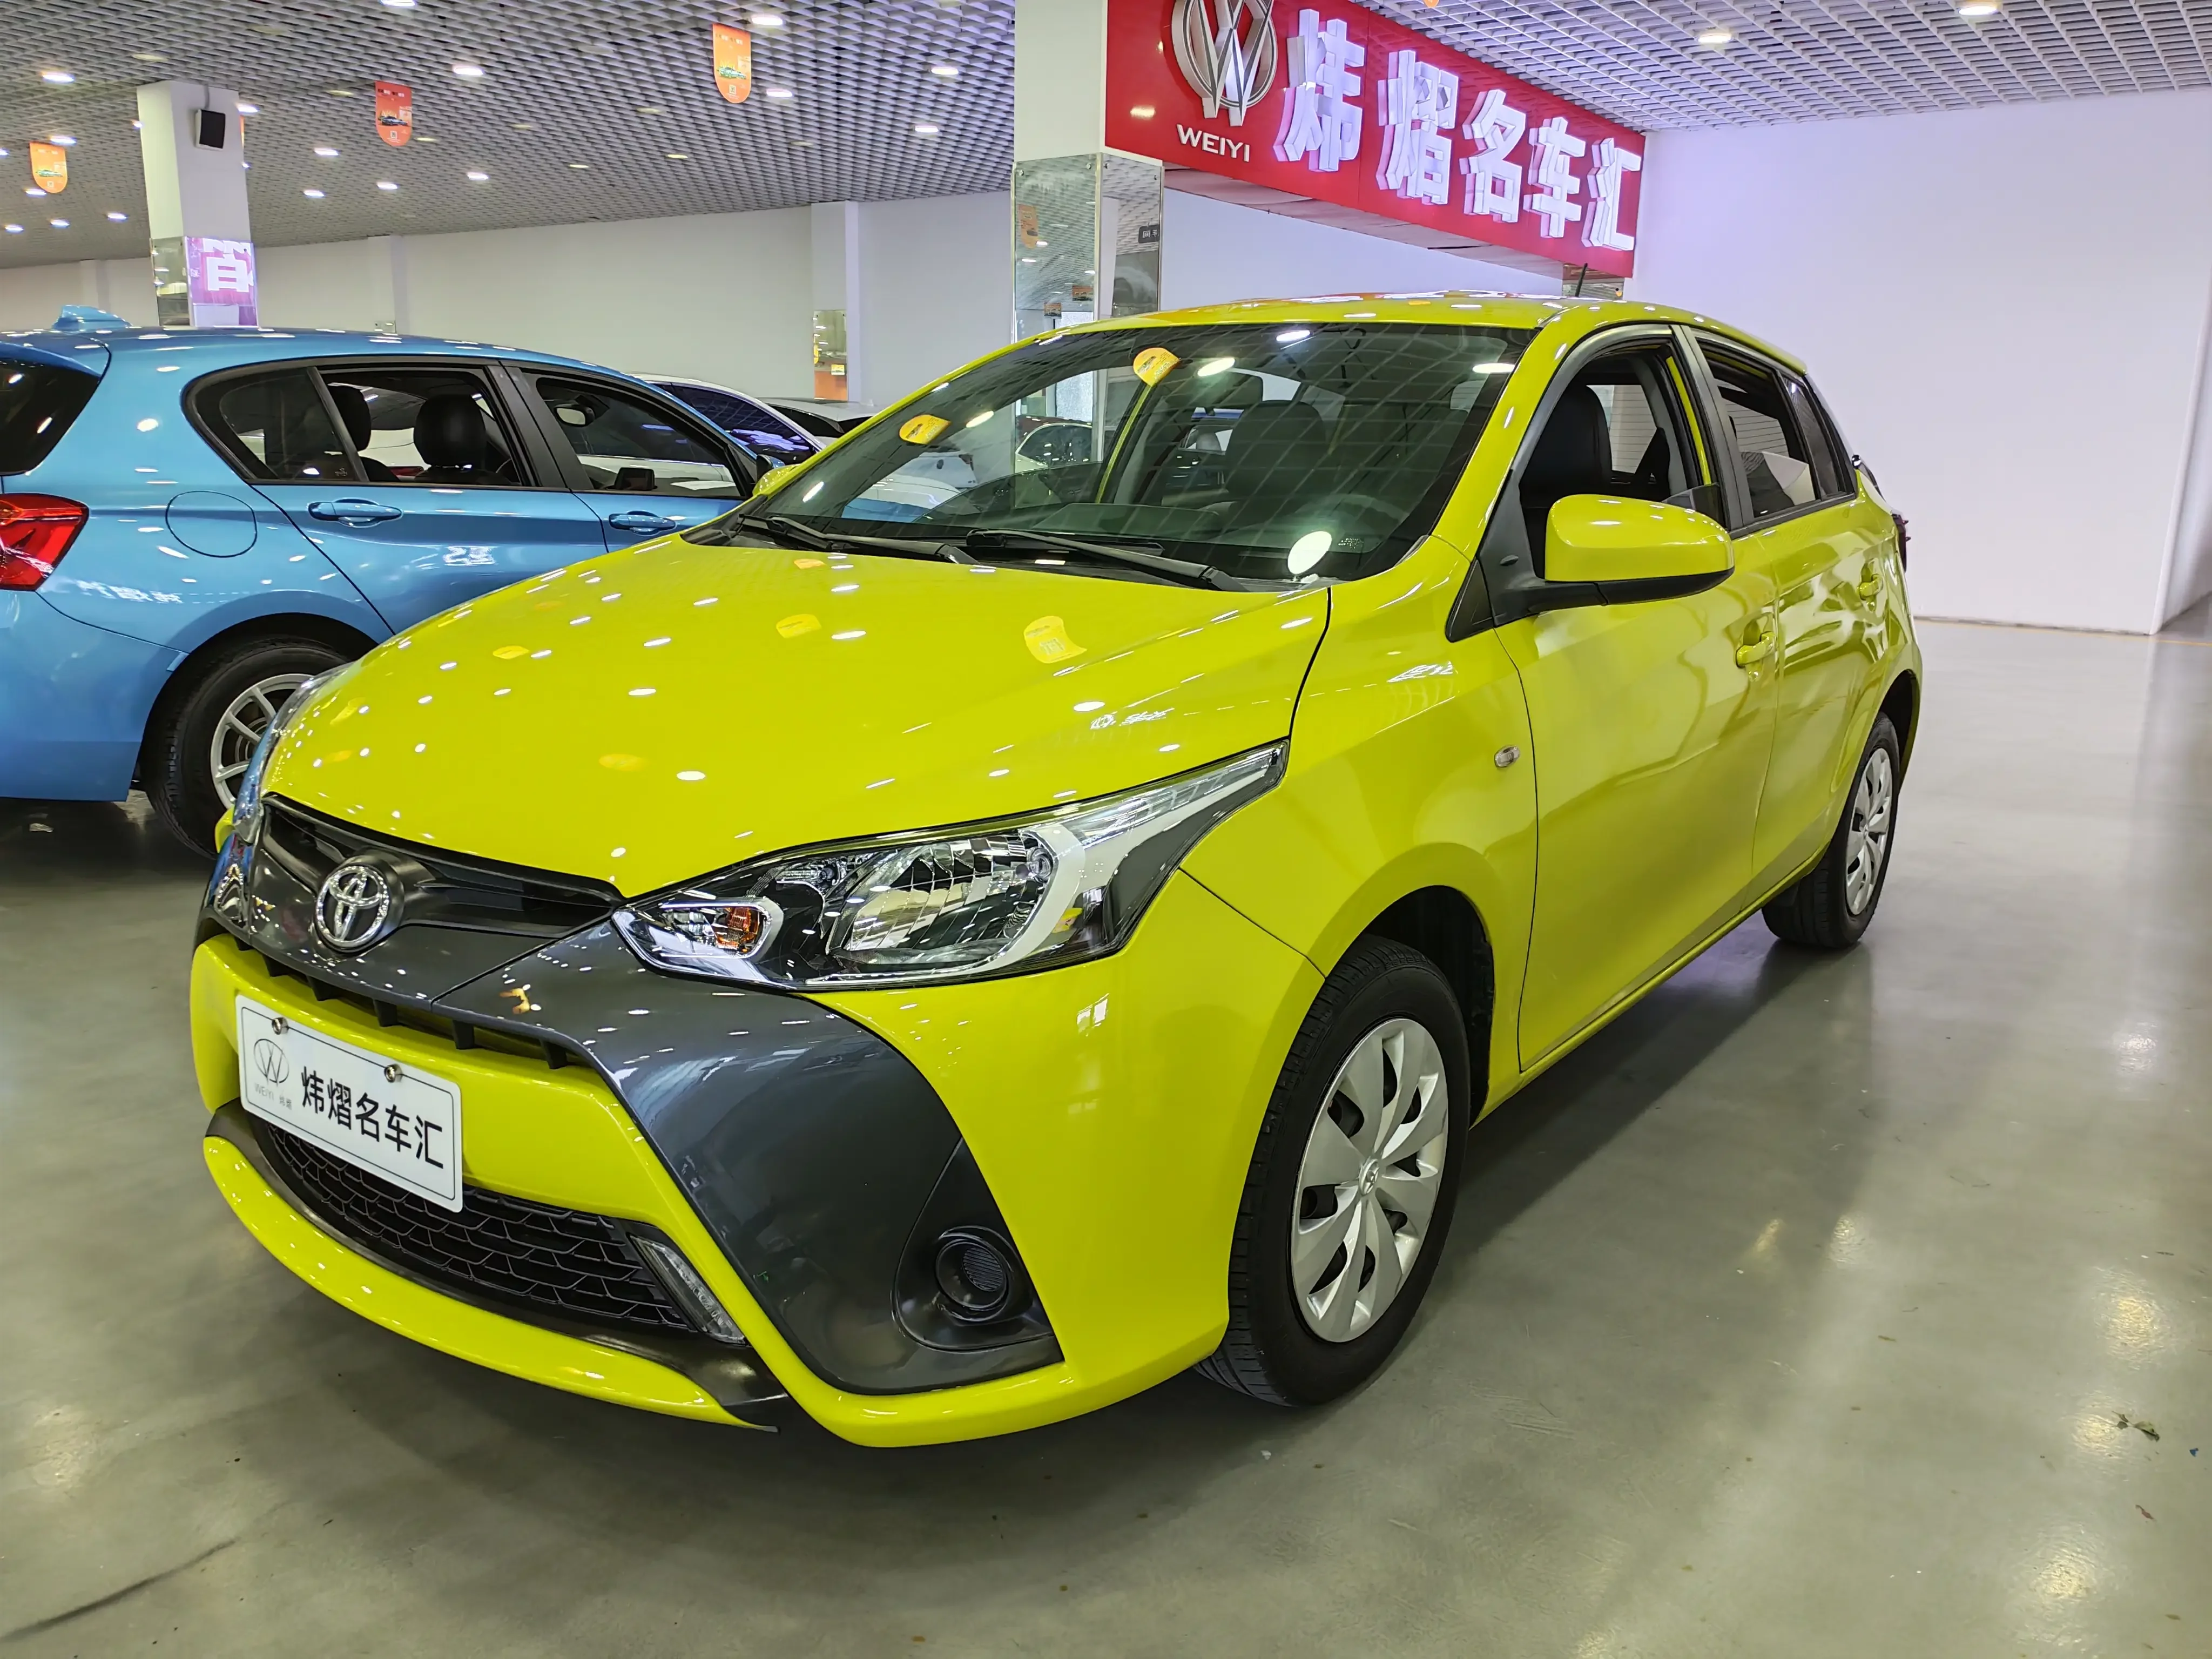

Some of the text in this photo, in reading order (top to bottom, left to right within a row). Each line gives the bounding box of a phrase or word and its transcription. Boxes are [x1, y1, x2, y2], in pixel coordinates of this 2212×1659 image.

[1176, 124, 1250, 162] WEIYI
[1273, 9, 1642, 251] 炜熠名车汇
[301, 1065, 444, 1169] 炜熠名车汇
